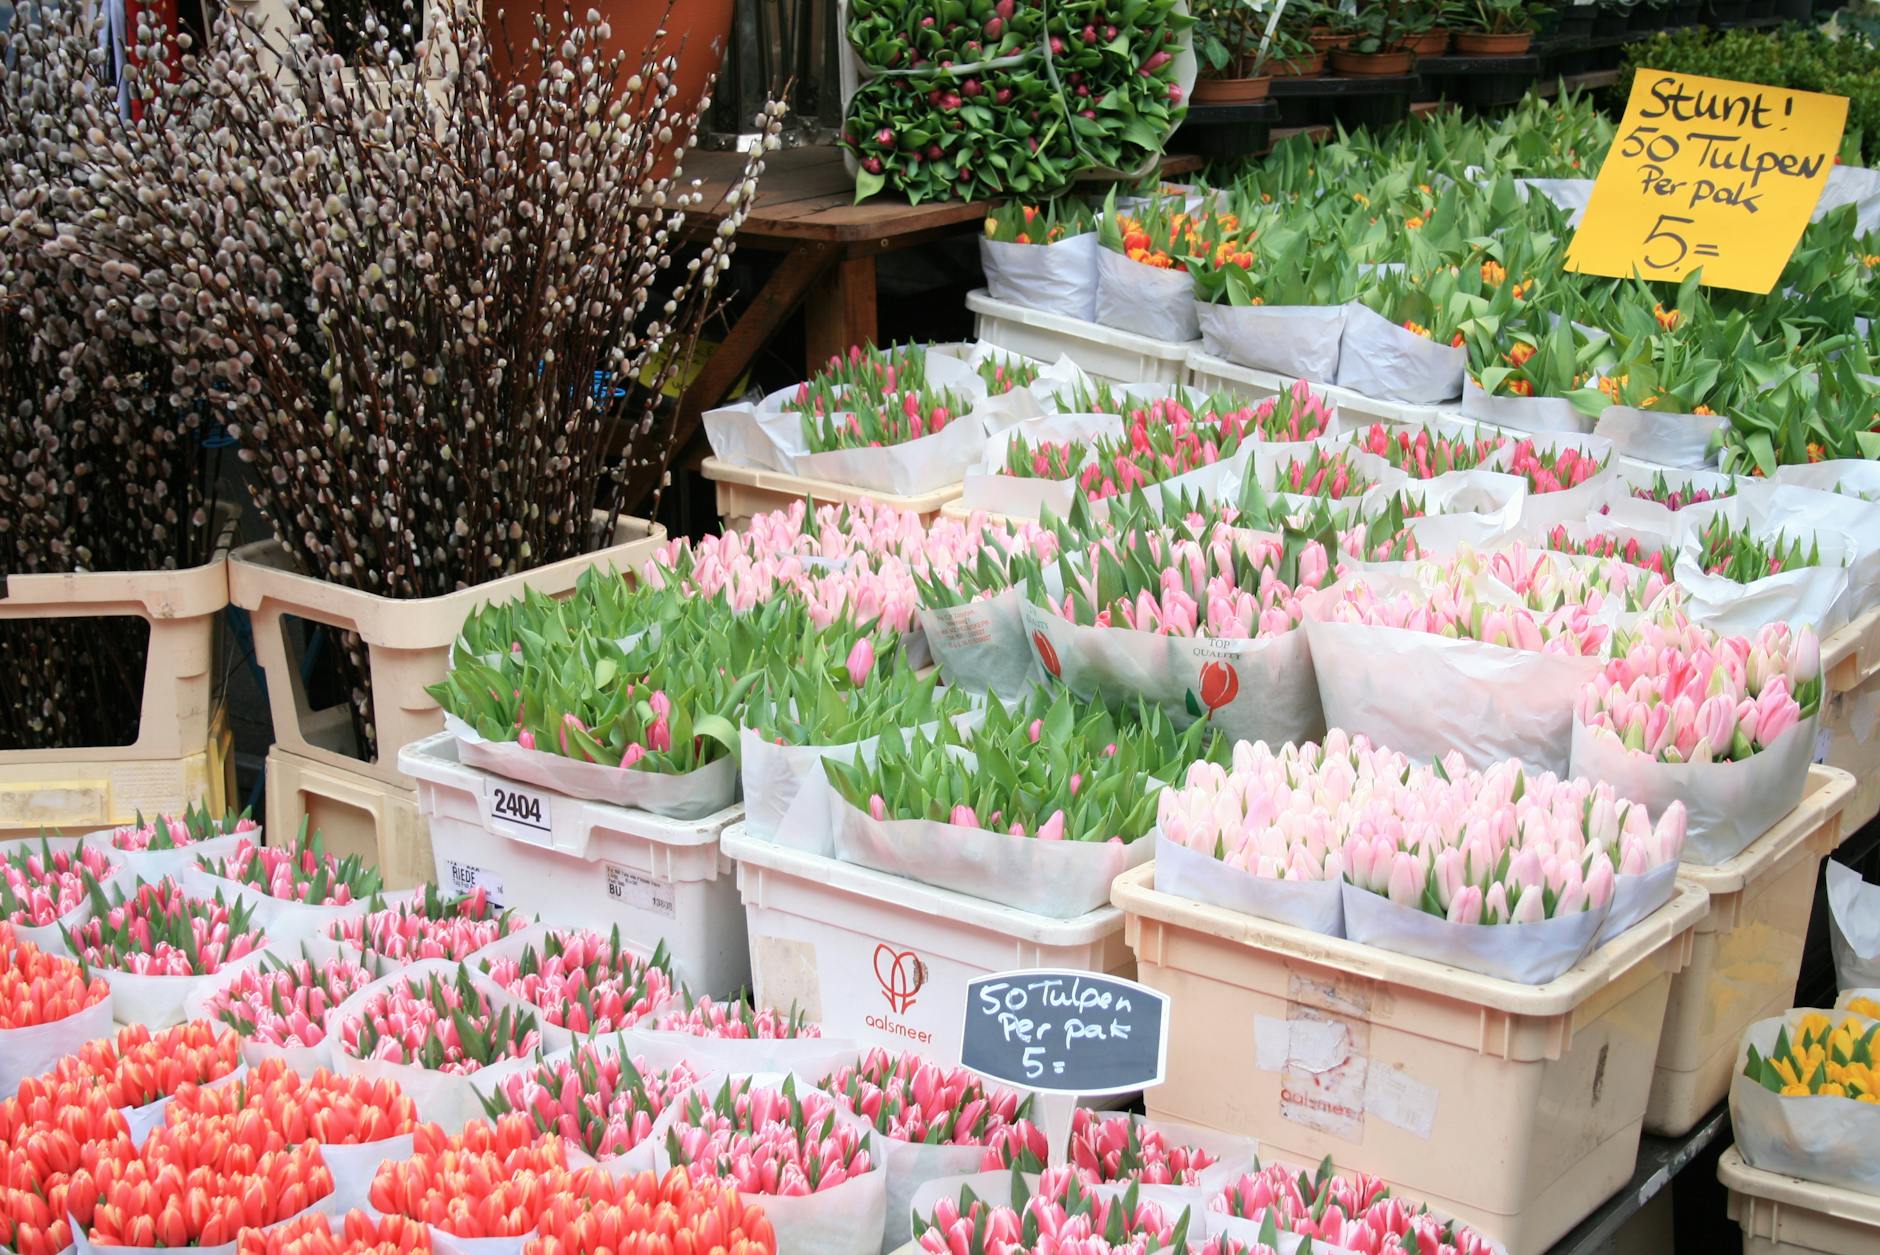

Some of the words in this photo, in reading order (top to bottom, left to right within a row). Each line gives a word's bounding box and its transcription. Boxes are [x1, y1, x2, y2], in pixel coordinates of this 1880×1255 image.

[1639, 77, 1793, 132] Stunt!
[1621, 126, 1680, 163] 50
[1637, 164, 1687, 196] Per
[1688, 179, 1764, 214] pak
[1209, 638, 1231, 649] TOP
[493, 788, 542, 823] 2404
[608, 883, 623, 897] BU
[979, 982, 1028, 1015] 50
[1027, 977, 1132, 1014] Tulpen
[864, 1014, 932, 1044] aalsmeer
[1063, 1017, 1132, 1050] pak
